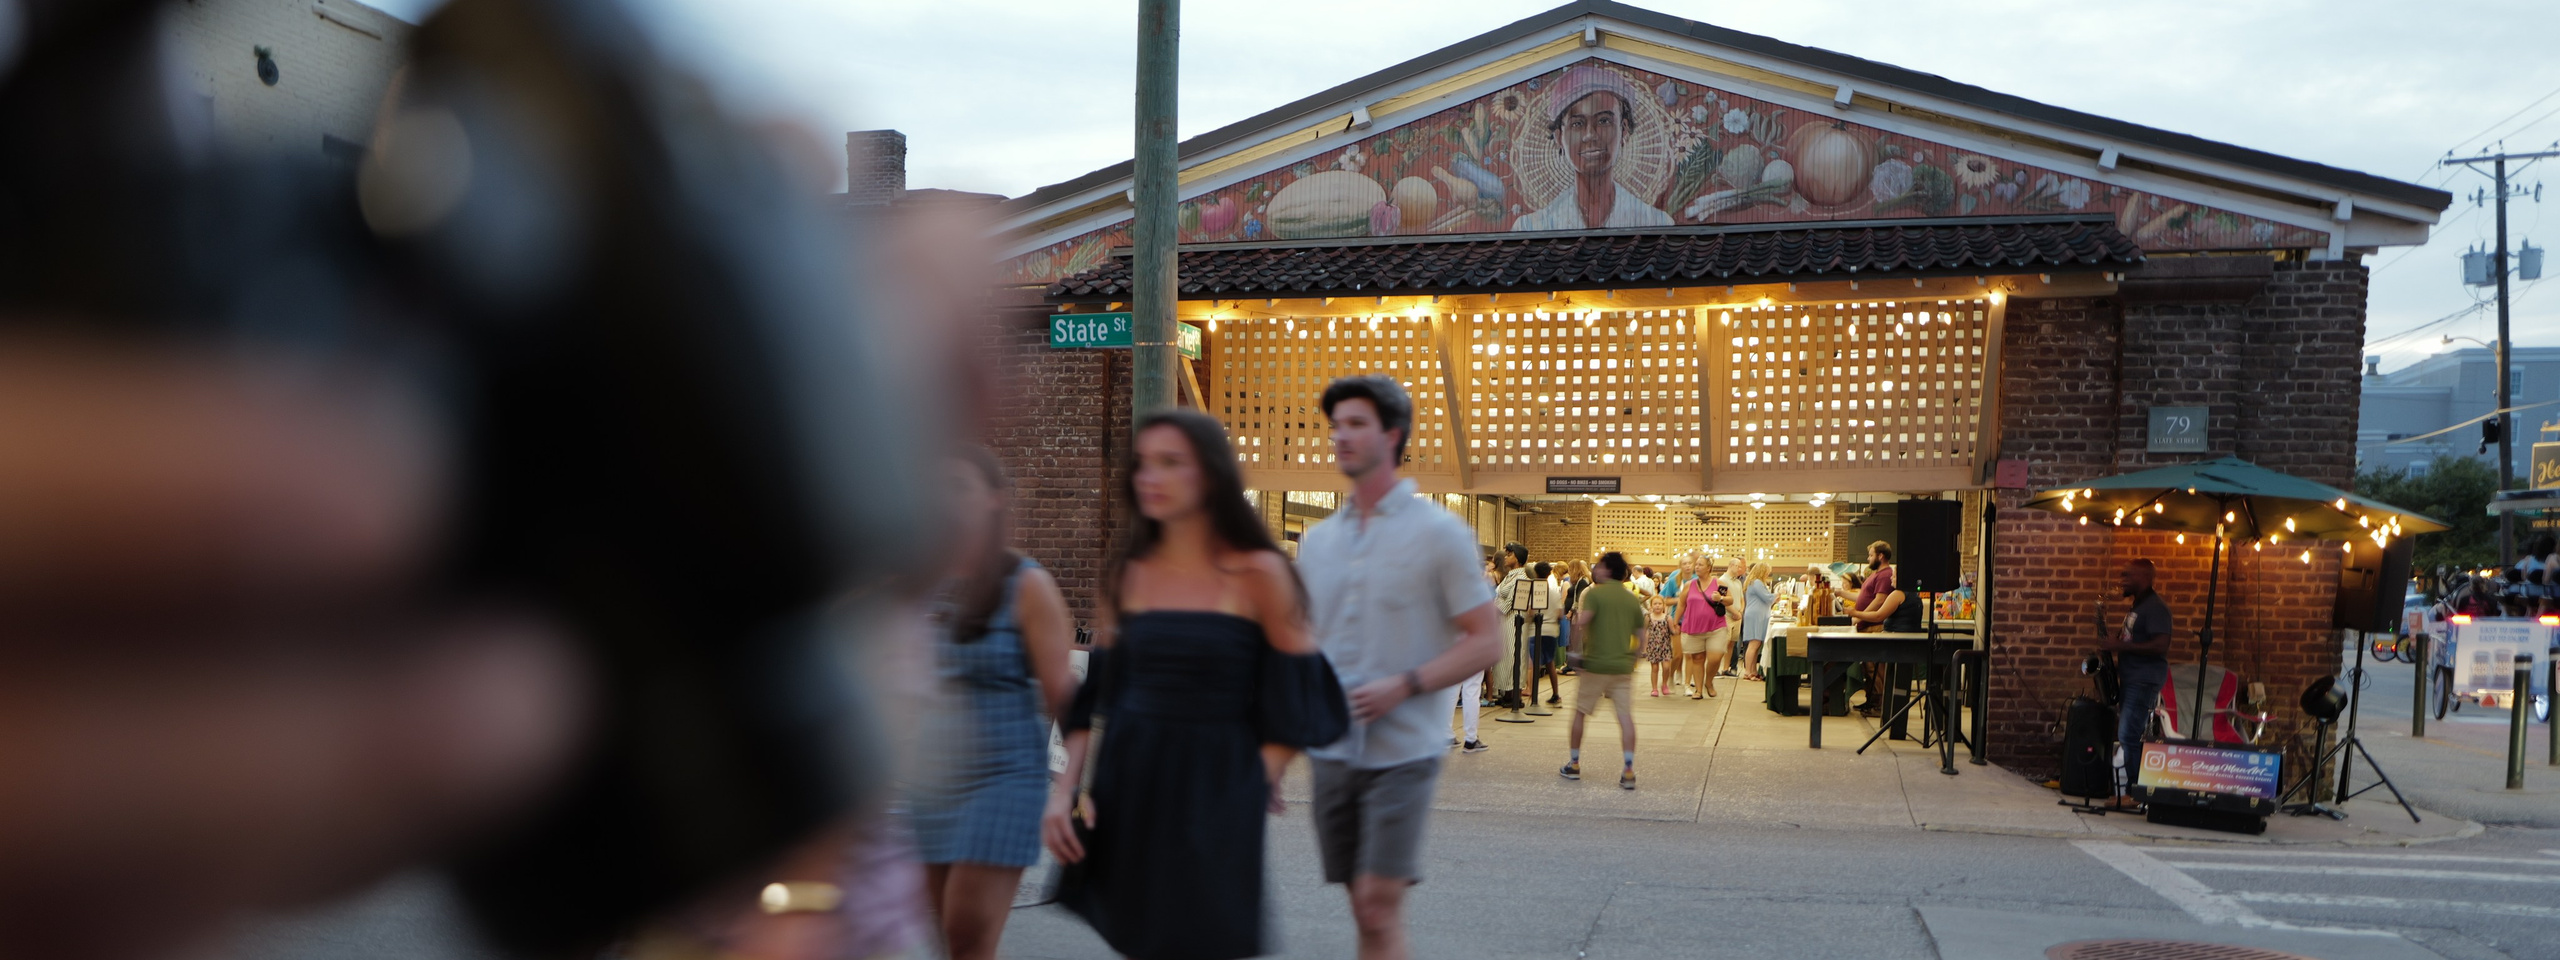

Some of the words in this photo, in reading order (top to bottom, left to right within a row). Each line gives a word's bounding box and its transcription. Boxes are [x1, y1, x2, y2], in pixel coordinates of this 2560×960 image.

[1055, 318, 1108, 343] State
[1114, 317, 1126, 332] St
[1178, 327, 1196, 352] arket
[2166, 416, 2191, 435] 79
[2531, 520, 2555, 528] VINTAE
[2178, 747, 2219, 757] Follow
[2183, 780, 2211, 788] Band
[2213, 783, 2263, 793] Available
